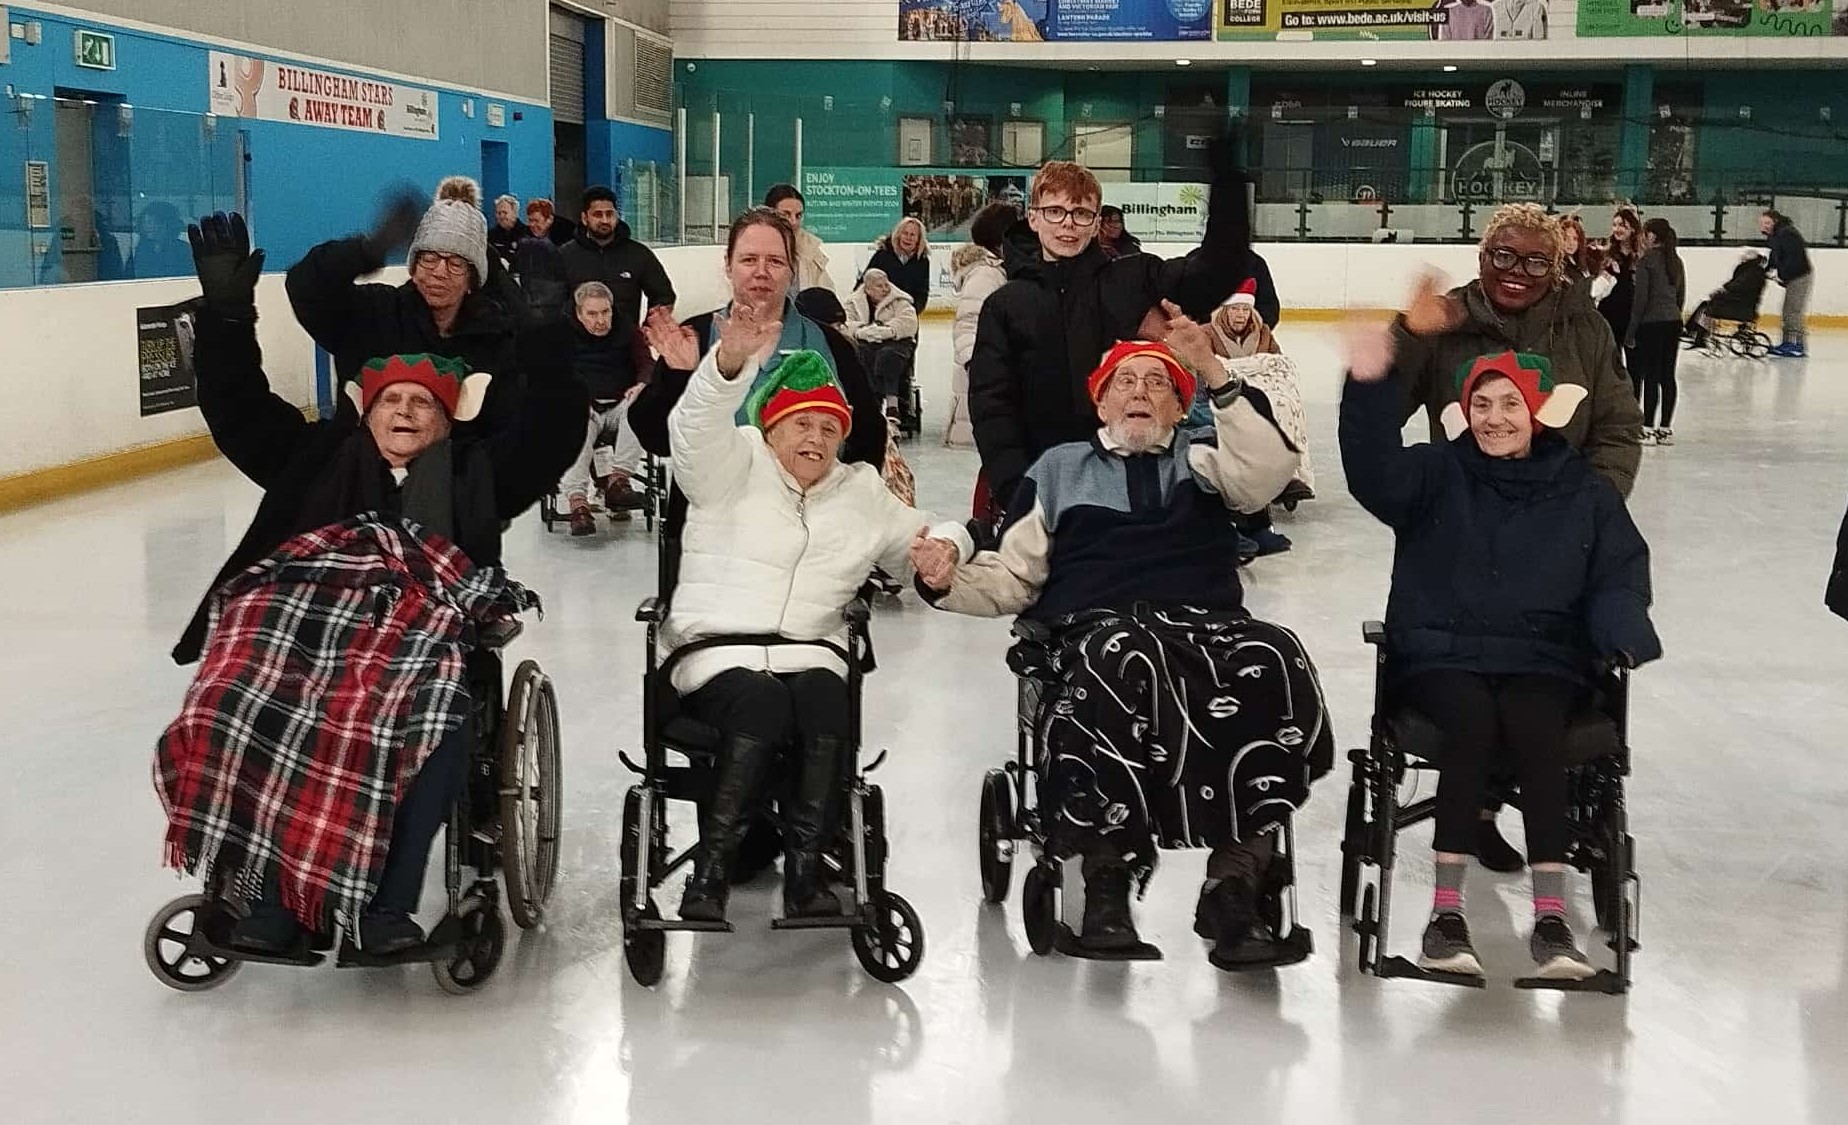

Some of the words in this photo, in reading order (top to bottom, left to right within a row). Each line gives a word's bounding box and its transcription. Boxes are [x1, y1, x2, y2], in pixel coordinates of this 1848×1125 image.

[1231, 0, 1261, 9] BEDE
[1230, 15, 1261, 23] COLLEGE
[1285, 15, 1299, 26] Go
[1302, 15, 1315, 25] to:
[1318, 12, 1446, 25] www.bede.ac.uk/visit-us
[278, 67, 359, 101] BILLINGHAM
[362, 80, 394, 106] STARS
[1414, 90, 1426, 98] ICE
[1429, 90, 1463, 98] HOCKEY
[1560, 90, 1588, 98] INLINE
[1405, 100, 1434, 108] FIGURE
[1435, 100, 1470, 108] SKATING
[304, 99, 339, 124] AWAY
[341, 104, 373, 128] TEAM
[806, 173, 835, 183] ENJOY
[806, 185, 897, 196] STOCKTON-ON-TEES
[1121, 203, 1197, 217] Billingham
